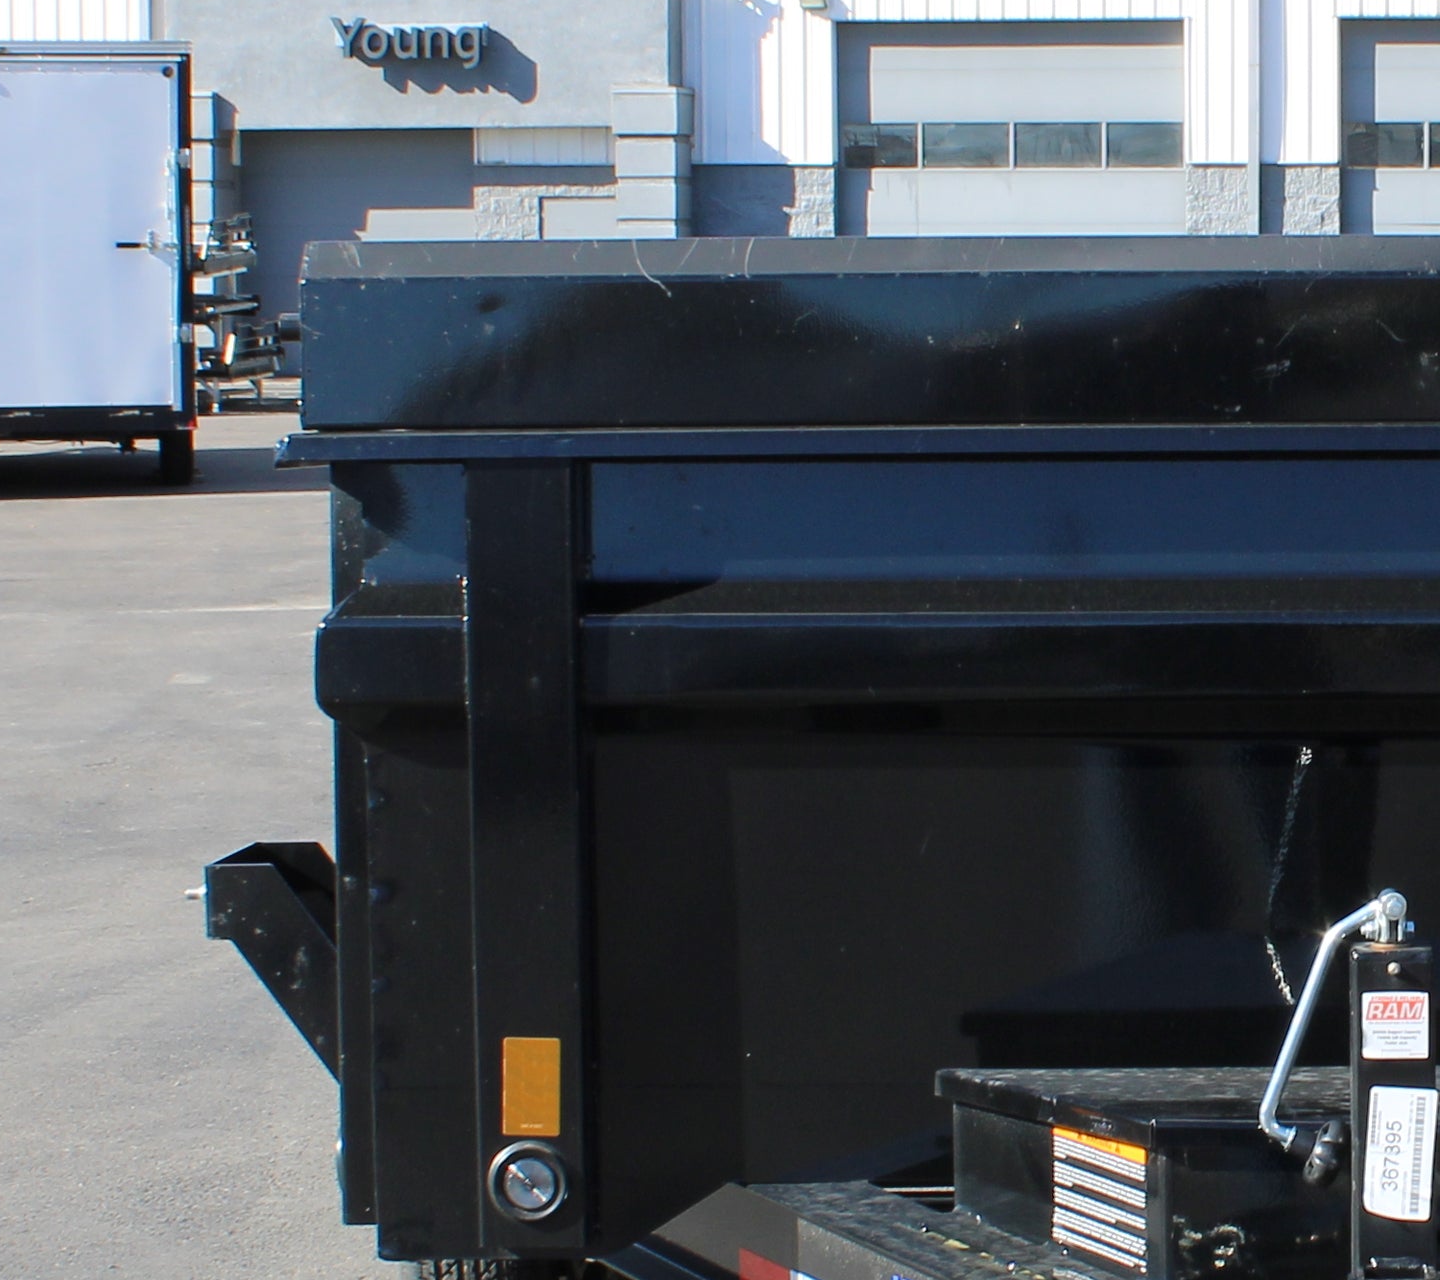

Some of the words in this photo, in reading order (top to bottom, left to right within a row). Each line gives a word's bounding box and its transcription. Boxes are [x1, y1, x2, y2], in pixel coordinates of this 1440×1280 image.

[329, 16, 481, 70] Young
[1367, 1001, 1423, 1020] RAM
[1381, 1120, 1403, 1192] 367395
